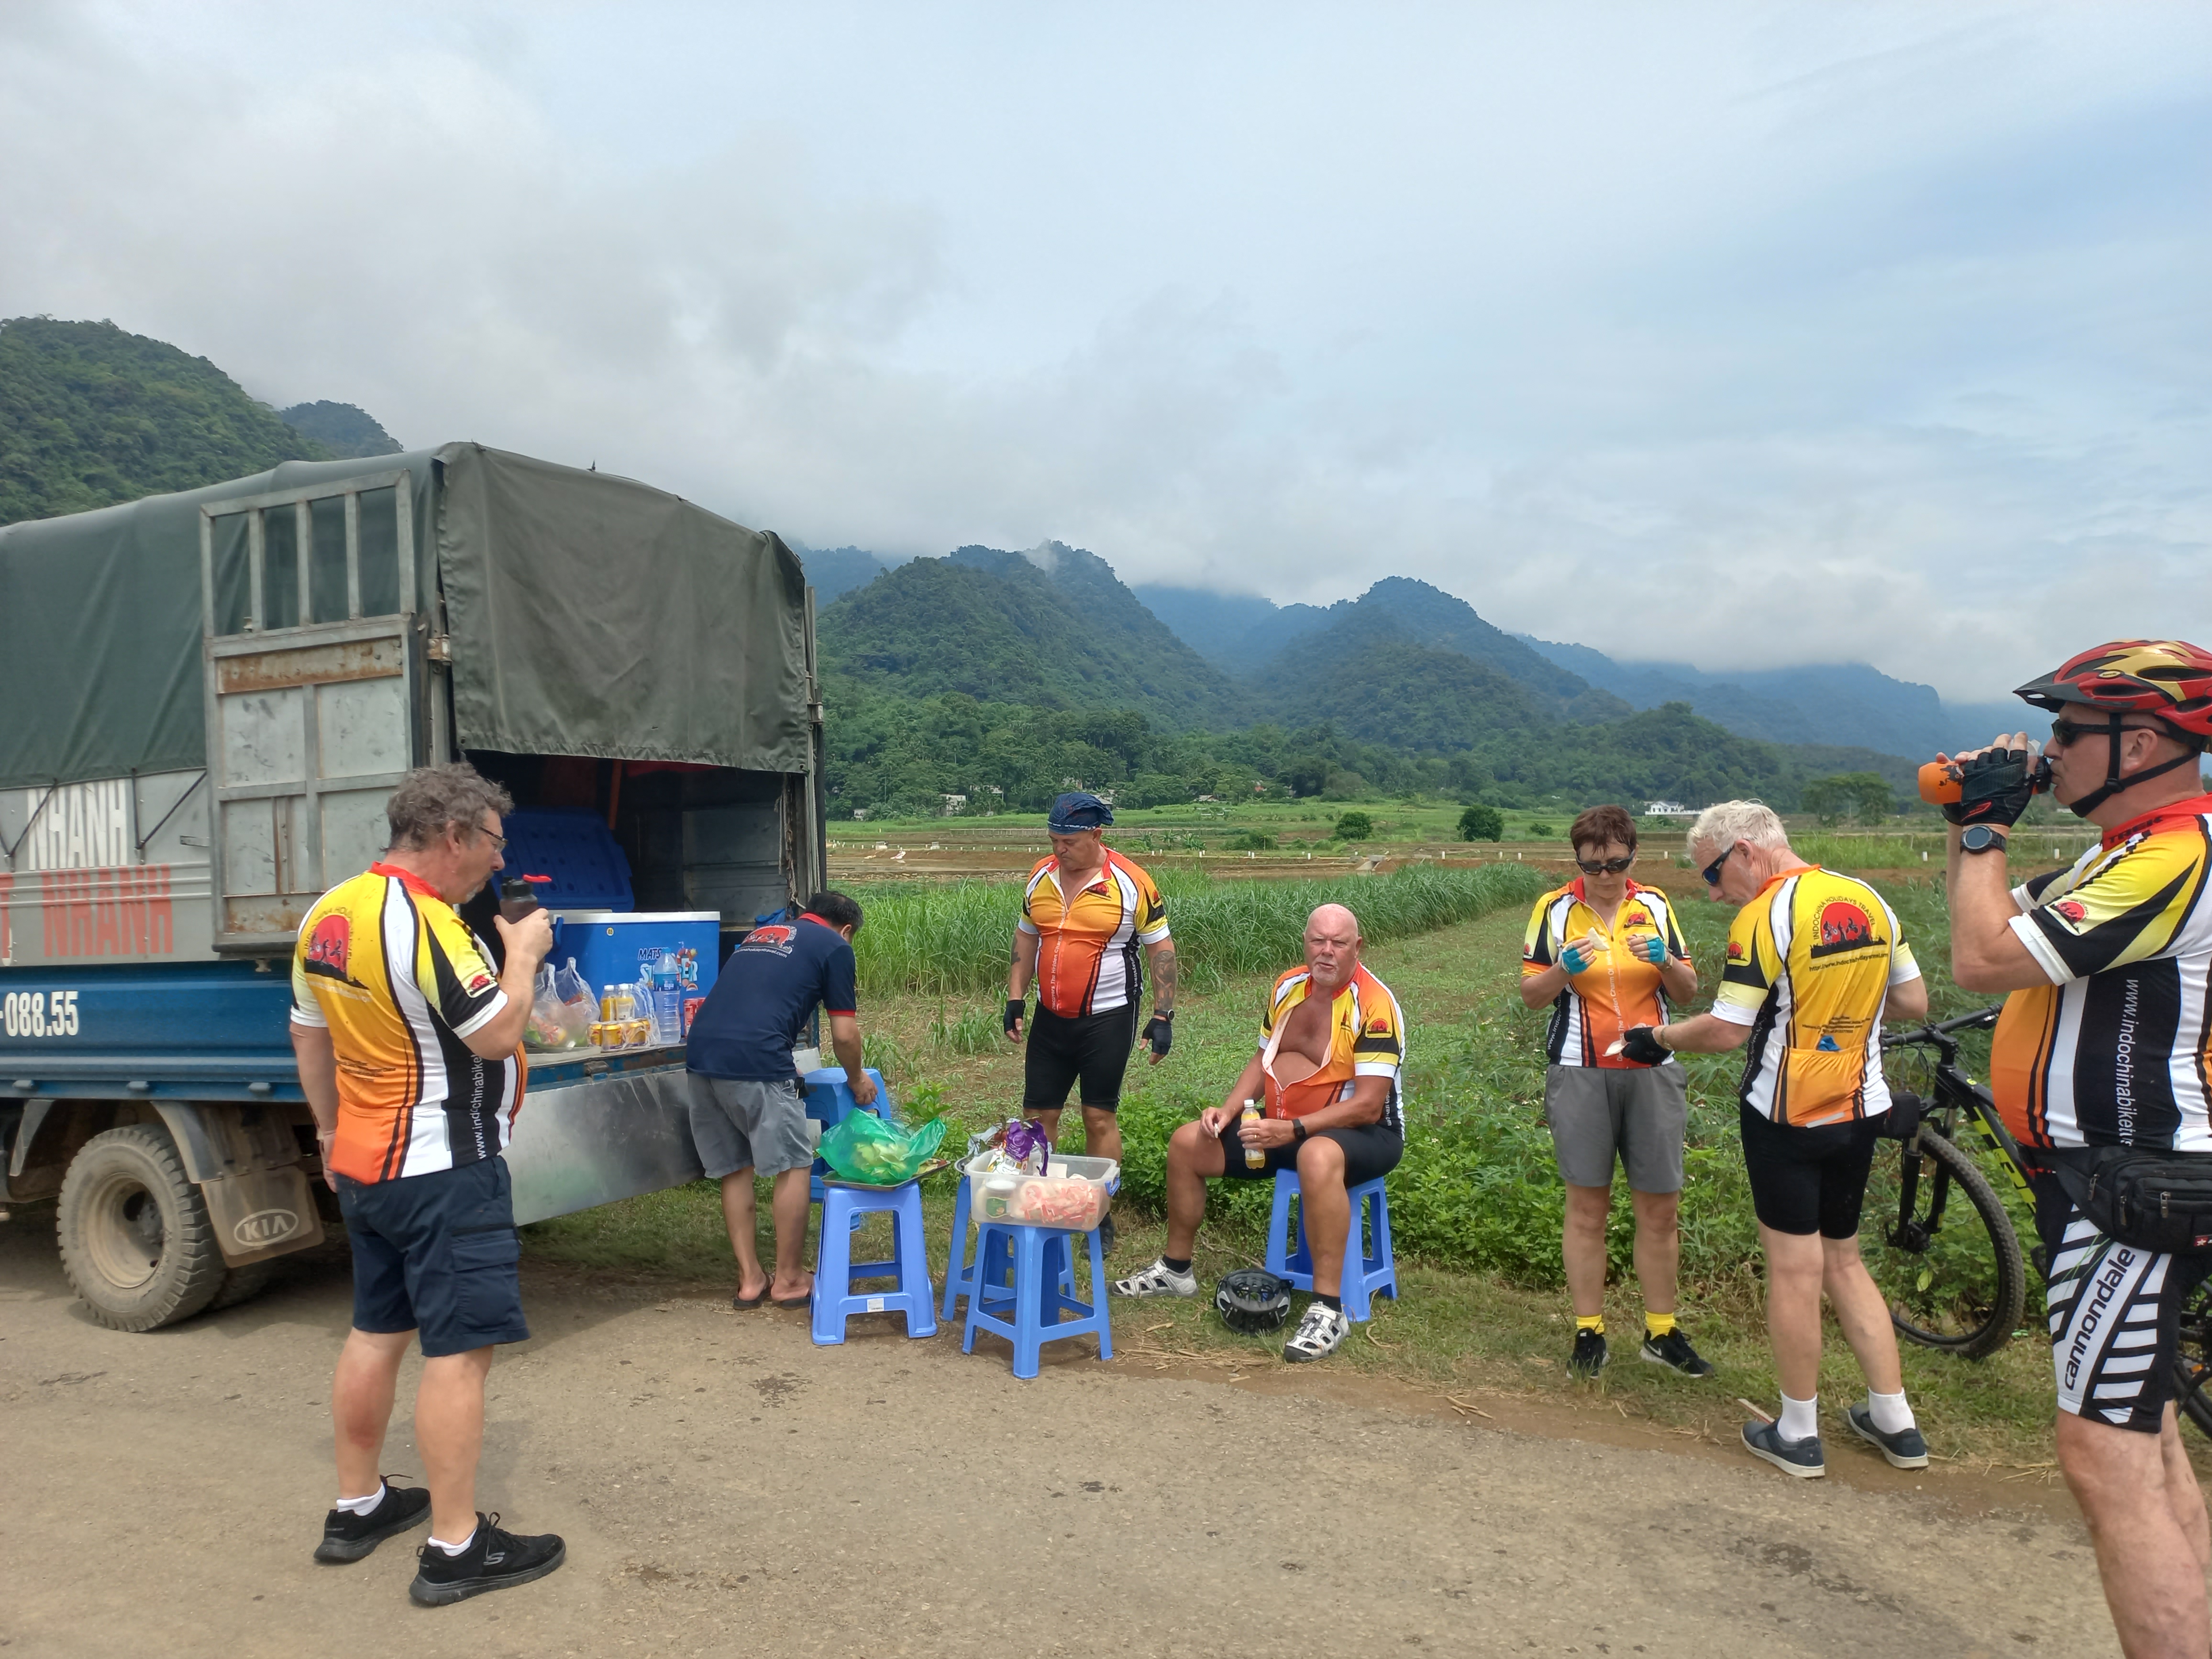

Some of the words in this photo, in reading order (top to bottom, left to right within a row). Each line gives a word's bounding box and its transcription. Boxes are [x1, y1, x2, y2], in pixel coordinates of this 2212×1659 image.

[28, 779, 128, 871] NHANH
[2108, 815, 2164, 844] TREK
[41, 864, 174, 957] NHANH
[1812, 901, 1826, 940] INDOCHINA
[1825, 896, 1857, 905] HOLIDAYS
[1858, 902, 1876, 926] TRAVEL
[638, 947, 667, 961] MATS
[1054, 936, 1062, 953] Charm
[469, 1054, 487, 1160] www.indochinabike
[243, 1215, 289, 1241] KIA
[2065, 1248, 2136, 1391] cannondale
